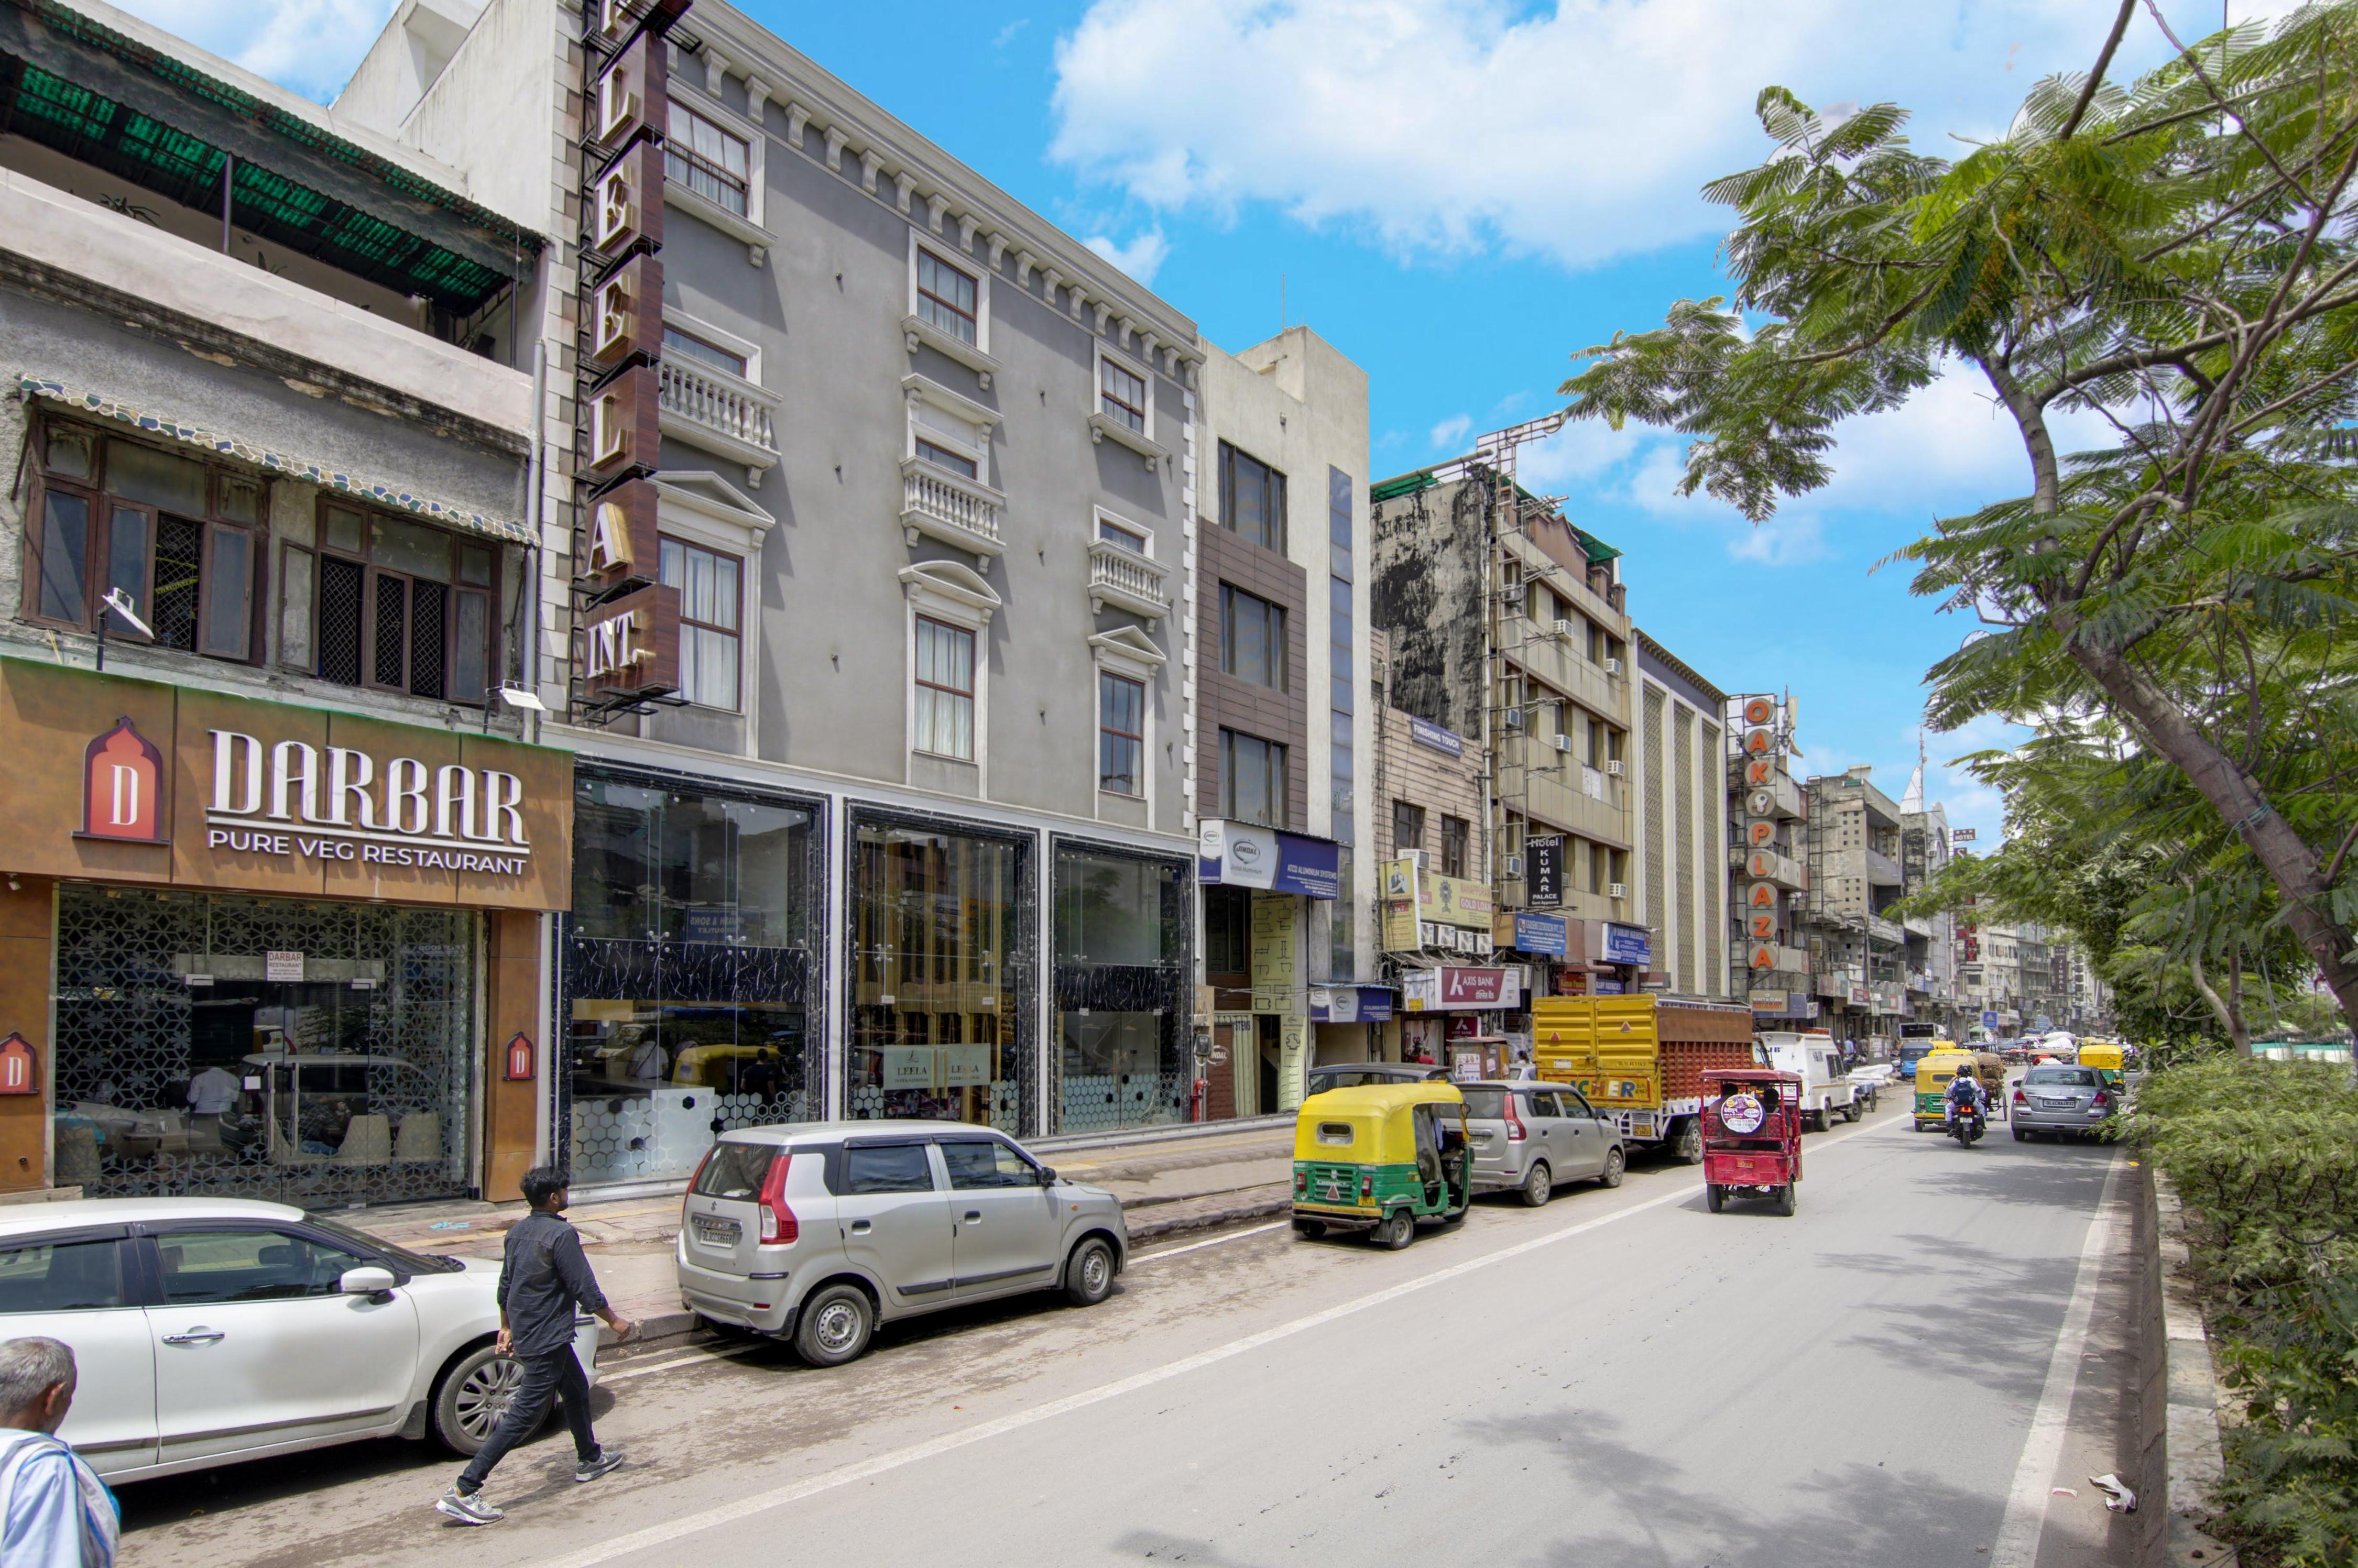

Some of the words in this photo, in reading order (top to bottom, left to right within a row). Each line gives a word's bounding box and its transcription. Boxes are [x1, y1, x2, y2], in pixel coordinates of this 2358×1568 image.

[1414, 724, 1440, 742] FINISHING
[1442, 734, 1459, 749] TOUCH
[206, 729, 529, 845] DARBAR
[111, 765, 138, 826] D
[1531, 837, 1558, 847] Hotel
[209, 830, 289, 855] PURE
[297, 840, 355, 861] VEG
[363, 844, 526, 875] RESTAURANT
[1236, 846, 1257, 855] JINDAL
[1287, 864, 1298, 873] ATCO
[1298, 866, 1319, 876] ALUMINIUM
[1320, 870, 1337, 880] SYSTEMS
[1540, 849, 1550, 892] KUMAR
[1751, 824, 1773, 969] PLAZA
[1461, 898, 1476, 909] GOLD
[1477, 901, 1492, 912] LOAN
[269, 952, 302, 961] DARBAR
[1462, 976, 1476, 986] AXIS
[1478, 977, 1494, 986] BANK
[897, 1066, 927, 1076] LEELA
[951, 1065, 979, 1073] LELA
[1558, 1080, 1635, 1098] ICHER
